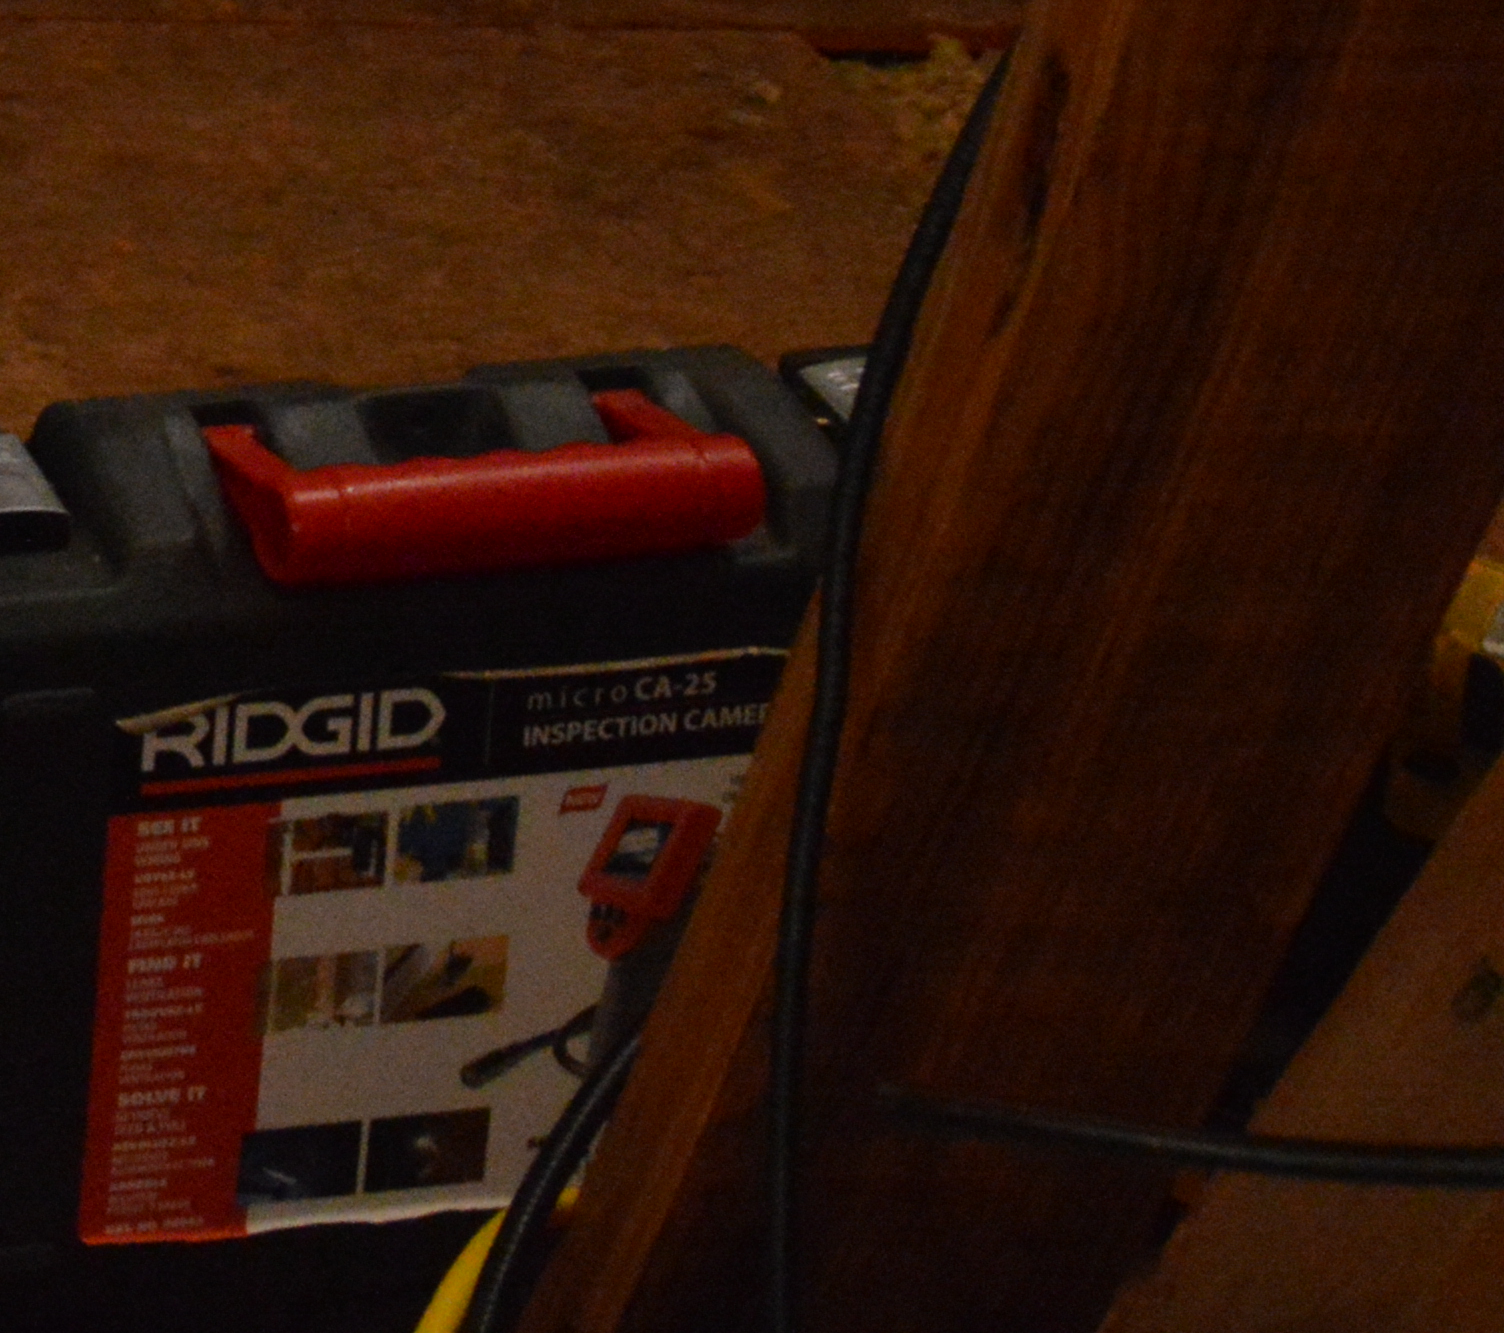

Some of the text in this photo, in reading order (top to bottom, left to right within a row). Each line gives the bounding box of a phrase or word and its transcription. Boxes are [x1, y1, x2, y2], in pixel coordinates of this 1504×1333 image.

[526, 670, 718, 712] micro CA-25
[140, 687, 446, 773] RIDGID
[522, 712, 679, 748] INSPECTION
[181, 815, 204, 834] IT
[127, 951, 204, 975] FIND IT
[117, 1084, 208, 1109] SOLVE IT
